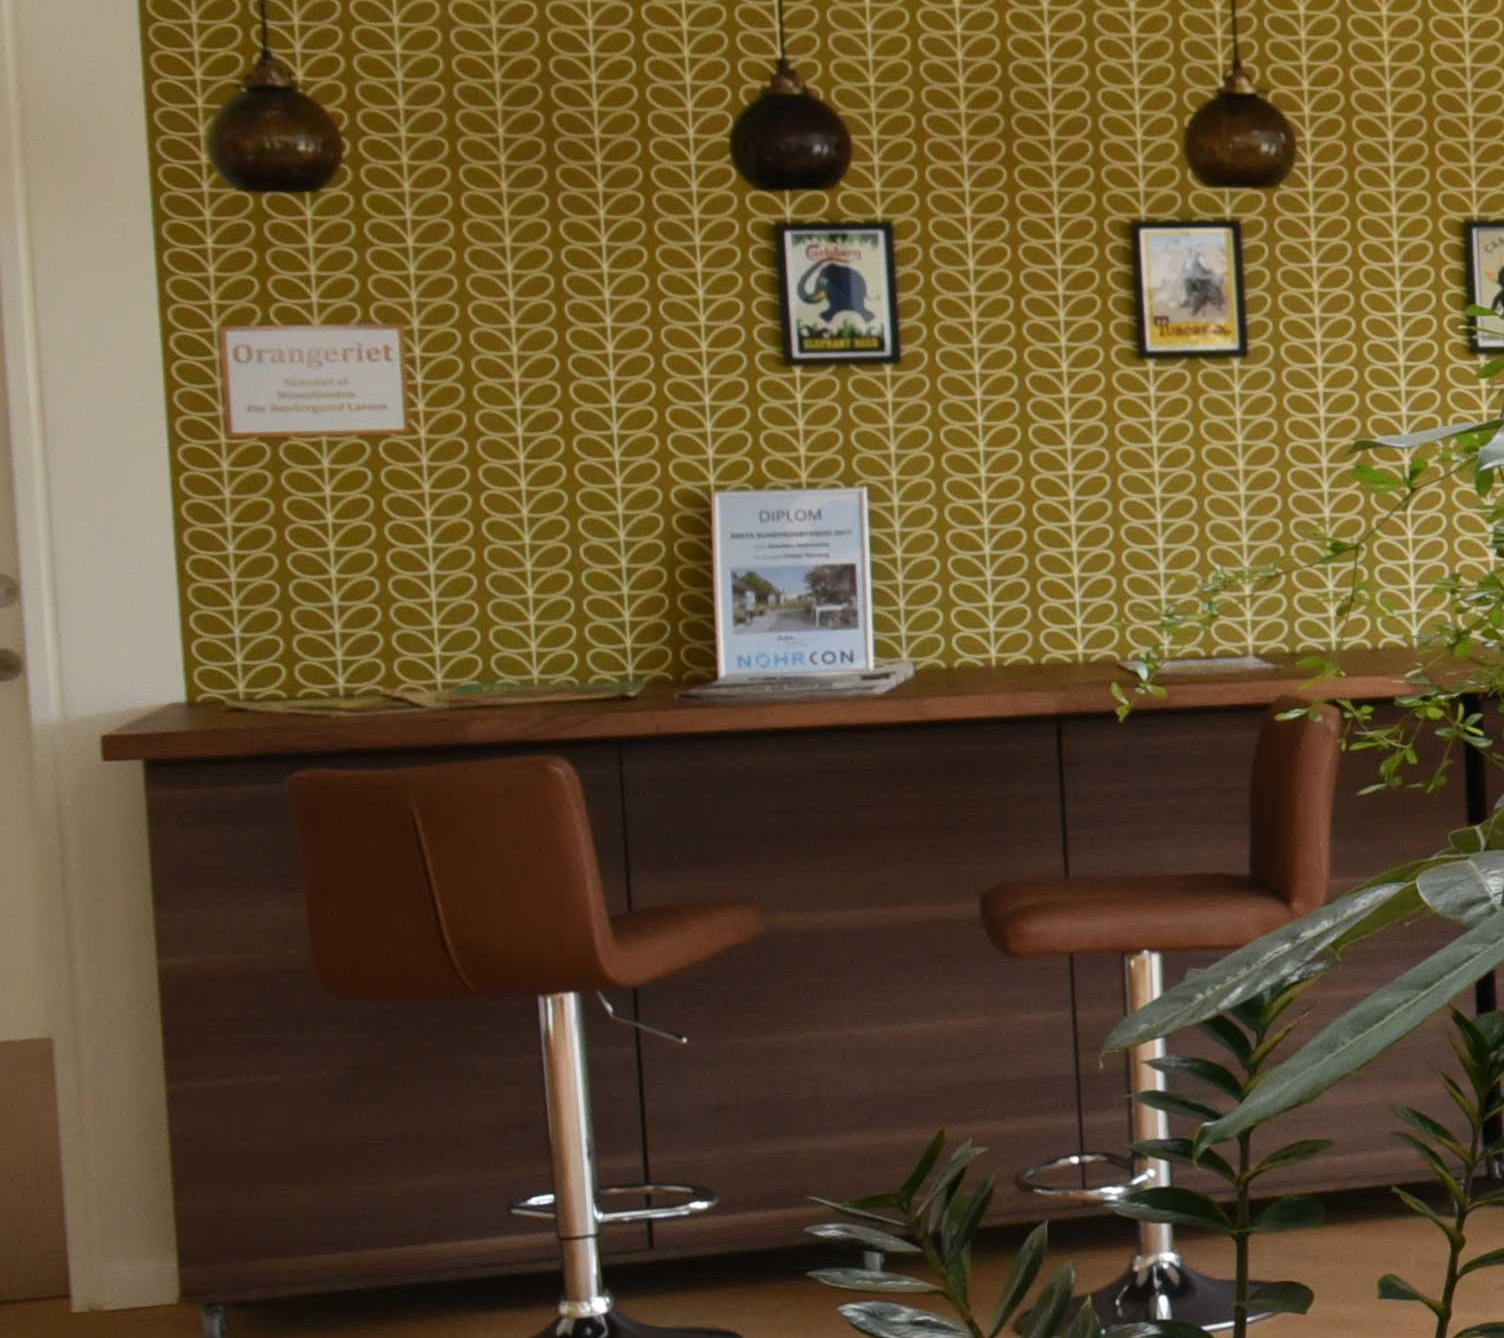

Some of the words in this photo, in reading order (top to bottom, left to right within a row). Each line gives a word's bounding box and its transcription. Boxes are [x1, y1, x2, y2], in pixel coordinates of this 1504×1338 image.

[805, 243, 863, 261] Carlsberg
[232, 342, 394, 368] Orangeriet
[759, 509, 822, 524] DIPLOM
